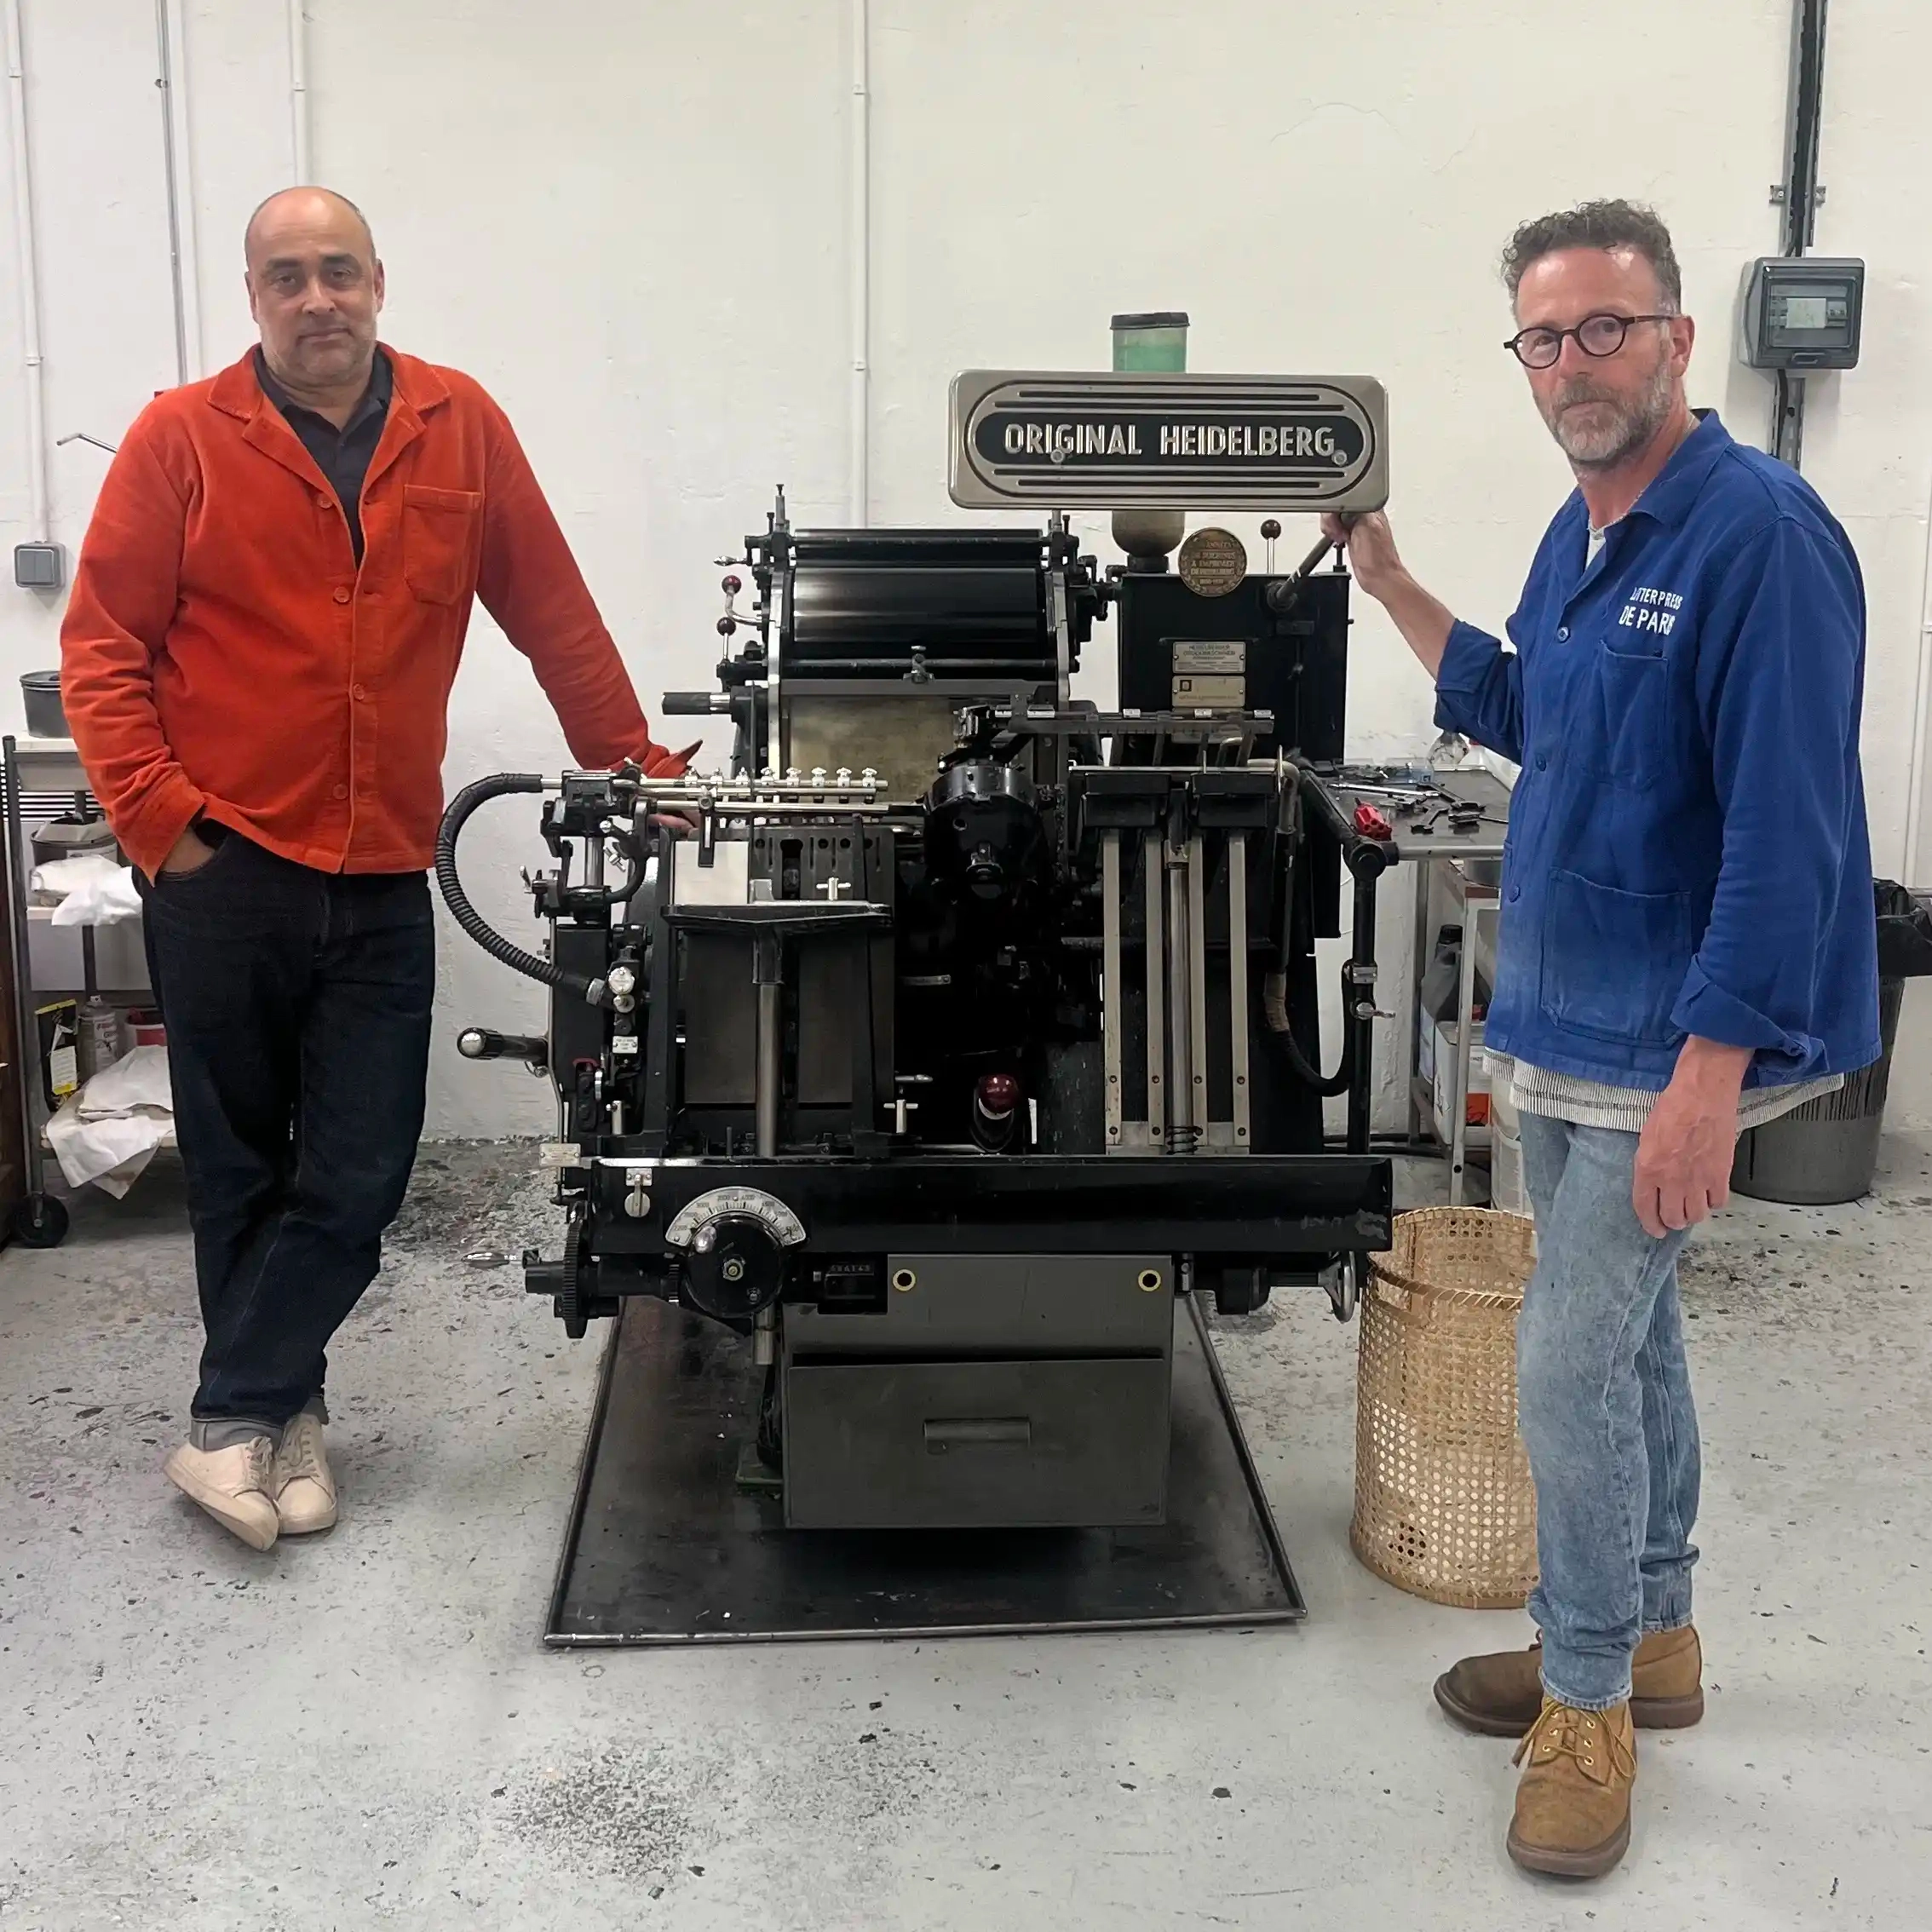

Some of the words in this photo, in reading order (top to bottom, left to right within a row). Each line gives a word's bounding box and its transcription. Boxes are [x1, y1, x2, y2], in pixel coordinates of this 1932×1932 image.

[1004, 423, 1142, 455] ORIGINAL
[1160, 425, 1335, 457] HEIDELBERG
[1630, 587, 1683, 610] LTTERPRESS
[1619, 605, 1636, 626] DE
